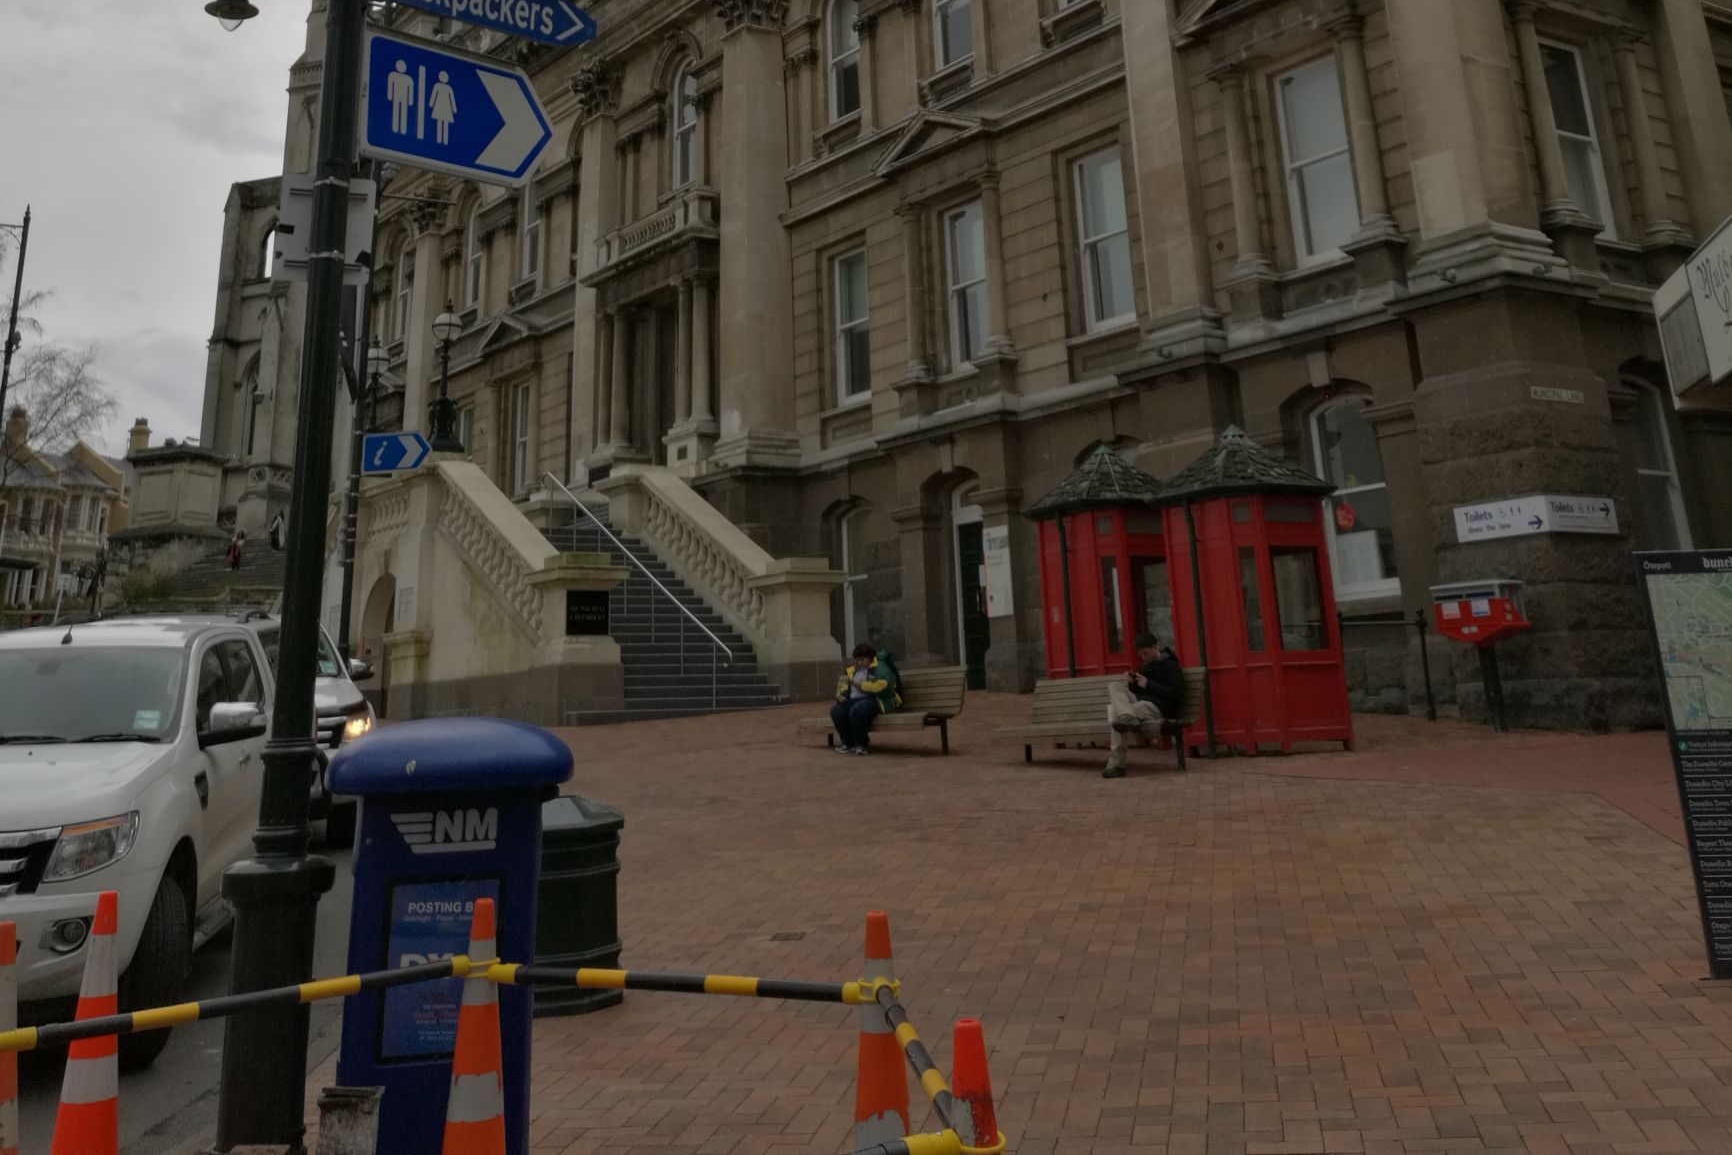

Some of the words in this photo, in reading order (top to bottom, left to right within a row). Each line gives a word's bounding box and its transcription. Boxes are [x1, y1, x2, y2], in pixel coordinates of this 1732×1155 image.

[1550, 501, 1575, 514] Toilets
[1463, 509, 1493, 523] Toilets
[408, 901, 462, 913] POSTING
